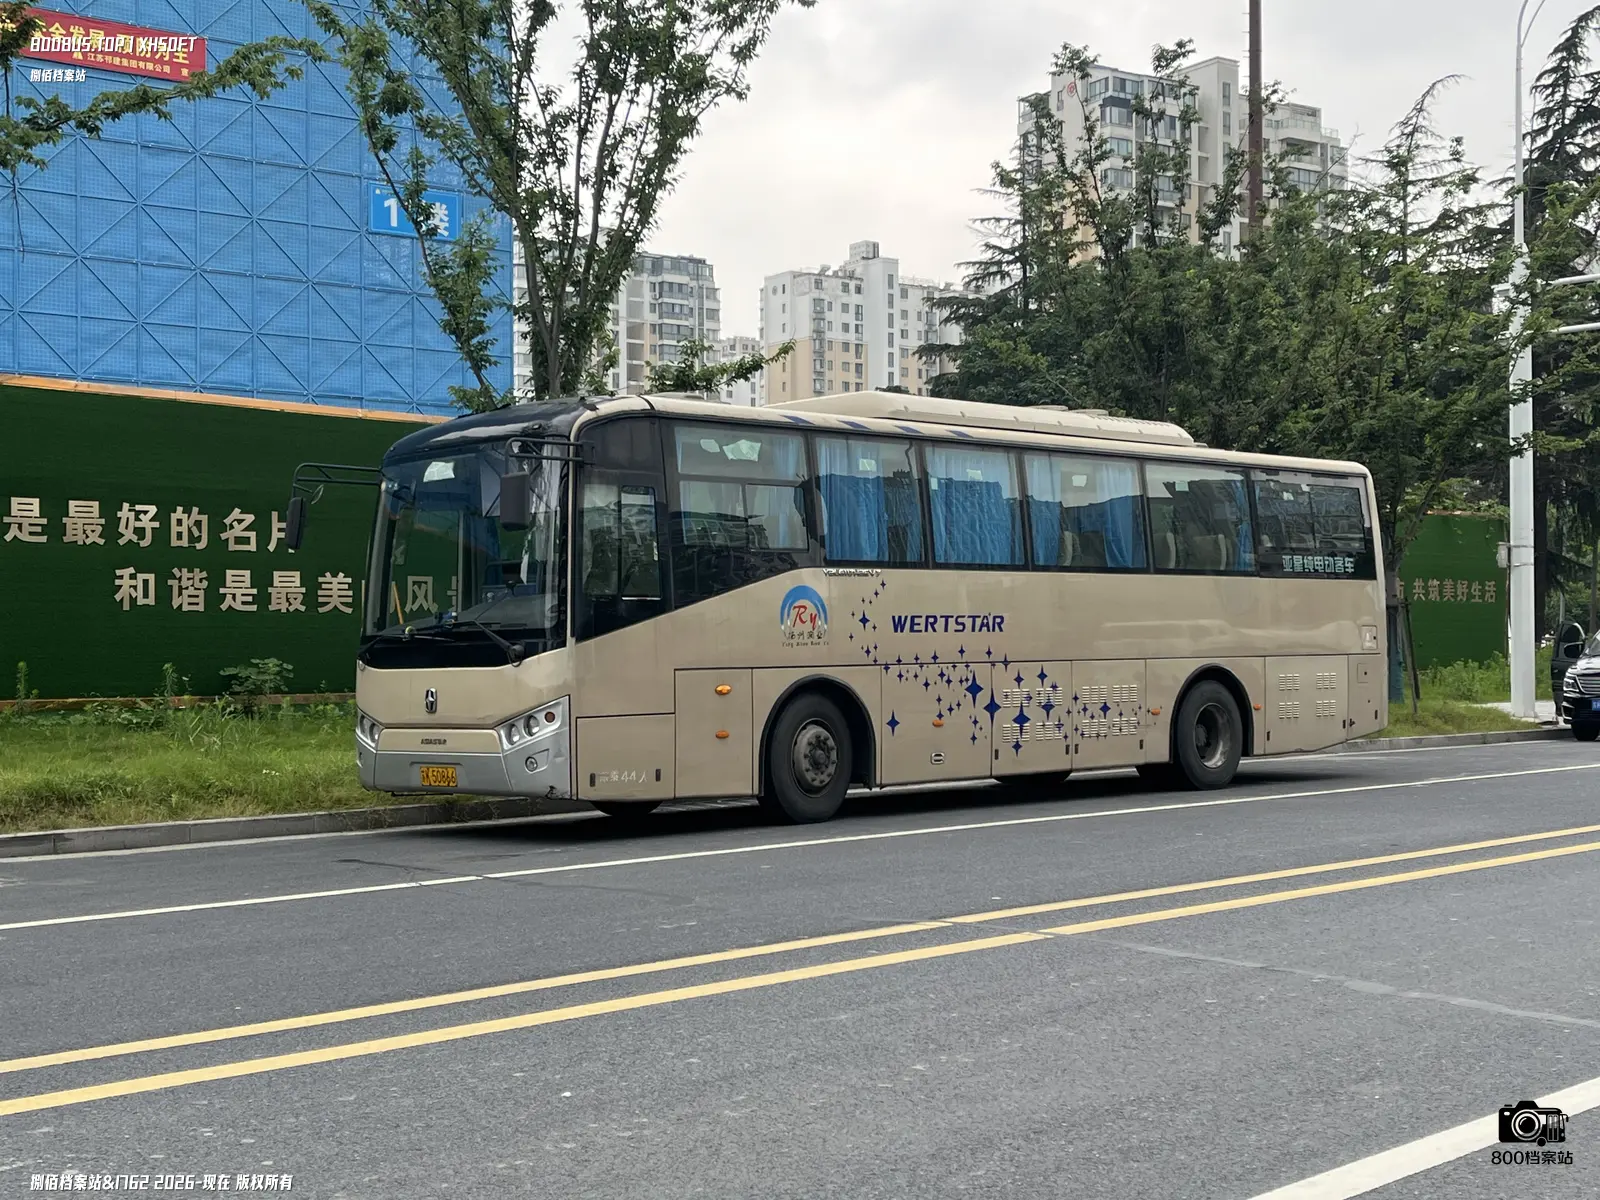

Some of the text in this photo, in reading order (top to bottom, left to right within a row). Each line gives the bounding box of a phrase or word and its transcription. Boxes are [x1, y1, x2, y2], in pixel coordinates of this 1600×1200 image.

[1282, 555, 1355, 574] 亚星纯电动客车
[1412, 578, 1497, 603] 共筑美好生活
[792, 604, 818, 631] Ry
[891, 614, 1006, 634] WERTSTAR
